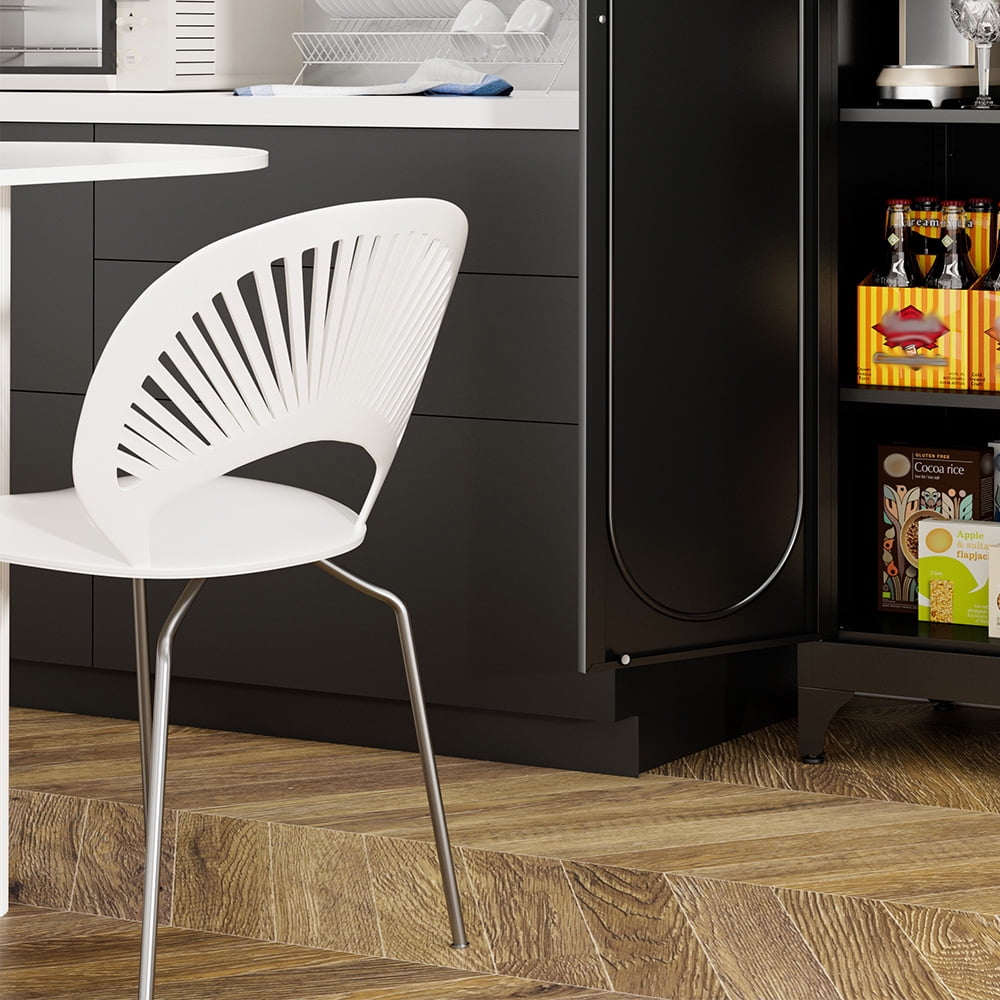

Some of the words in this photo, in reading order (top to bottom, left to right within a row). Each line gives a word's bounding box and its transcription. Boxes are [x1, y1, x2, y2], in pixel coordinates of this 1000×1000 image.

[914, 462, 944, 474] Cocoa
[947, 464, 964, 475] rice
[956, 530, 984, 540] Apple
[956, 550, 989, 561] flapjac
